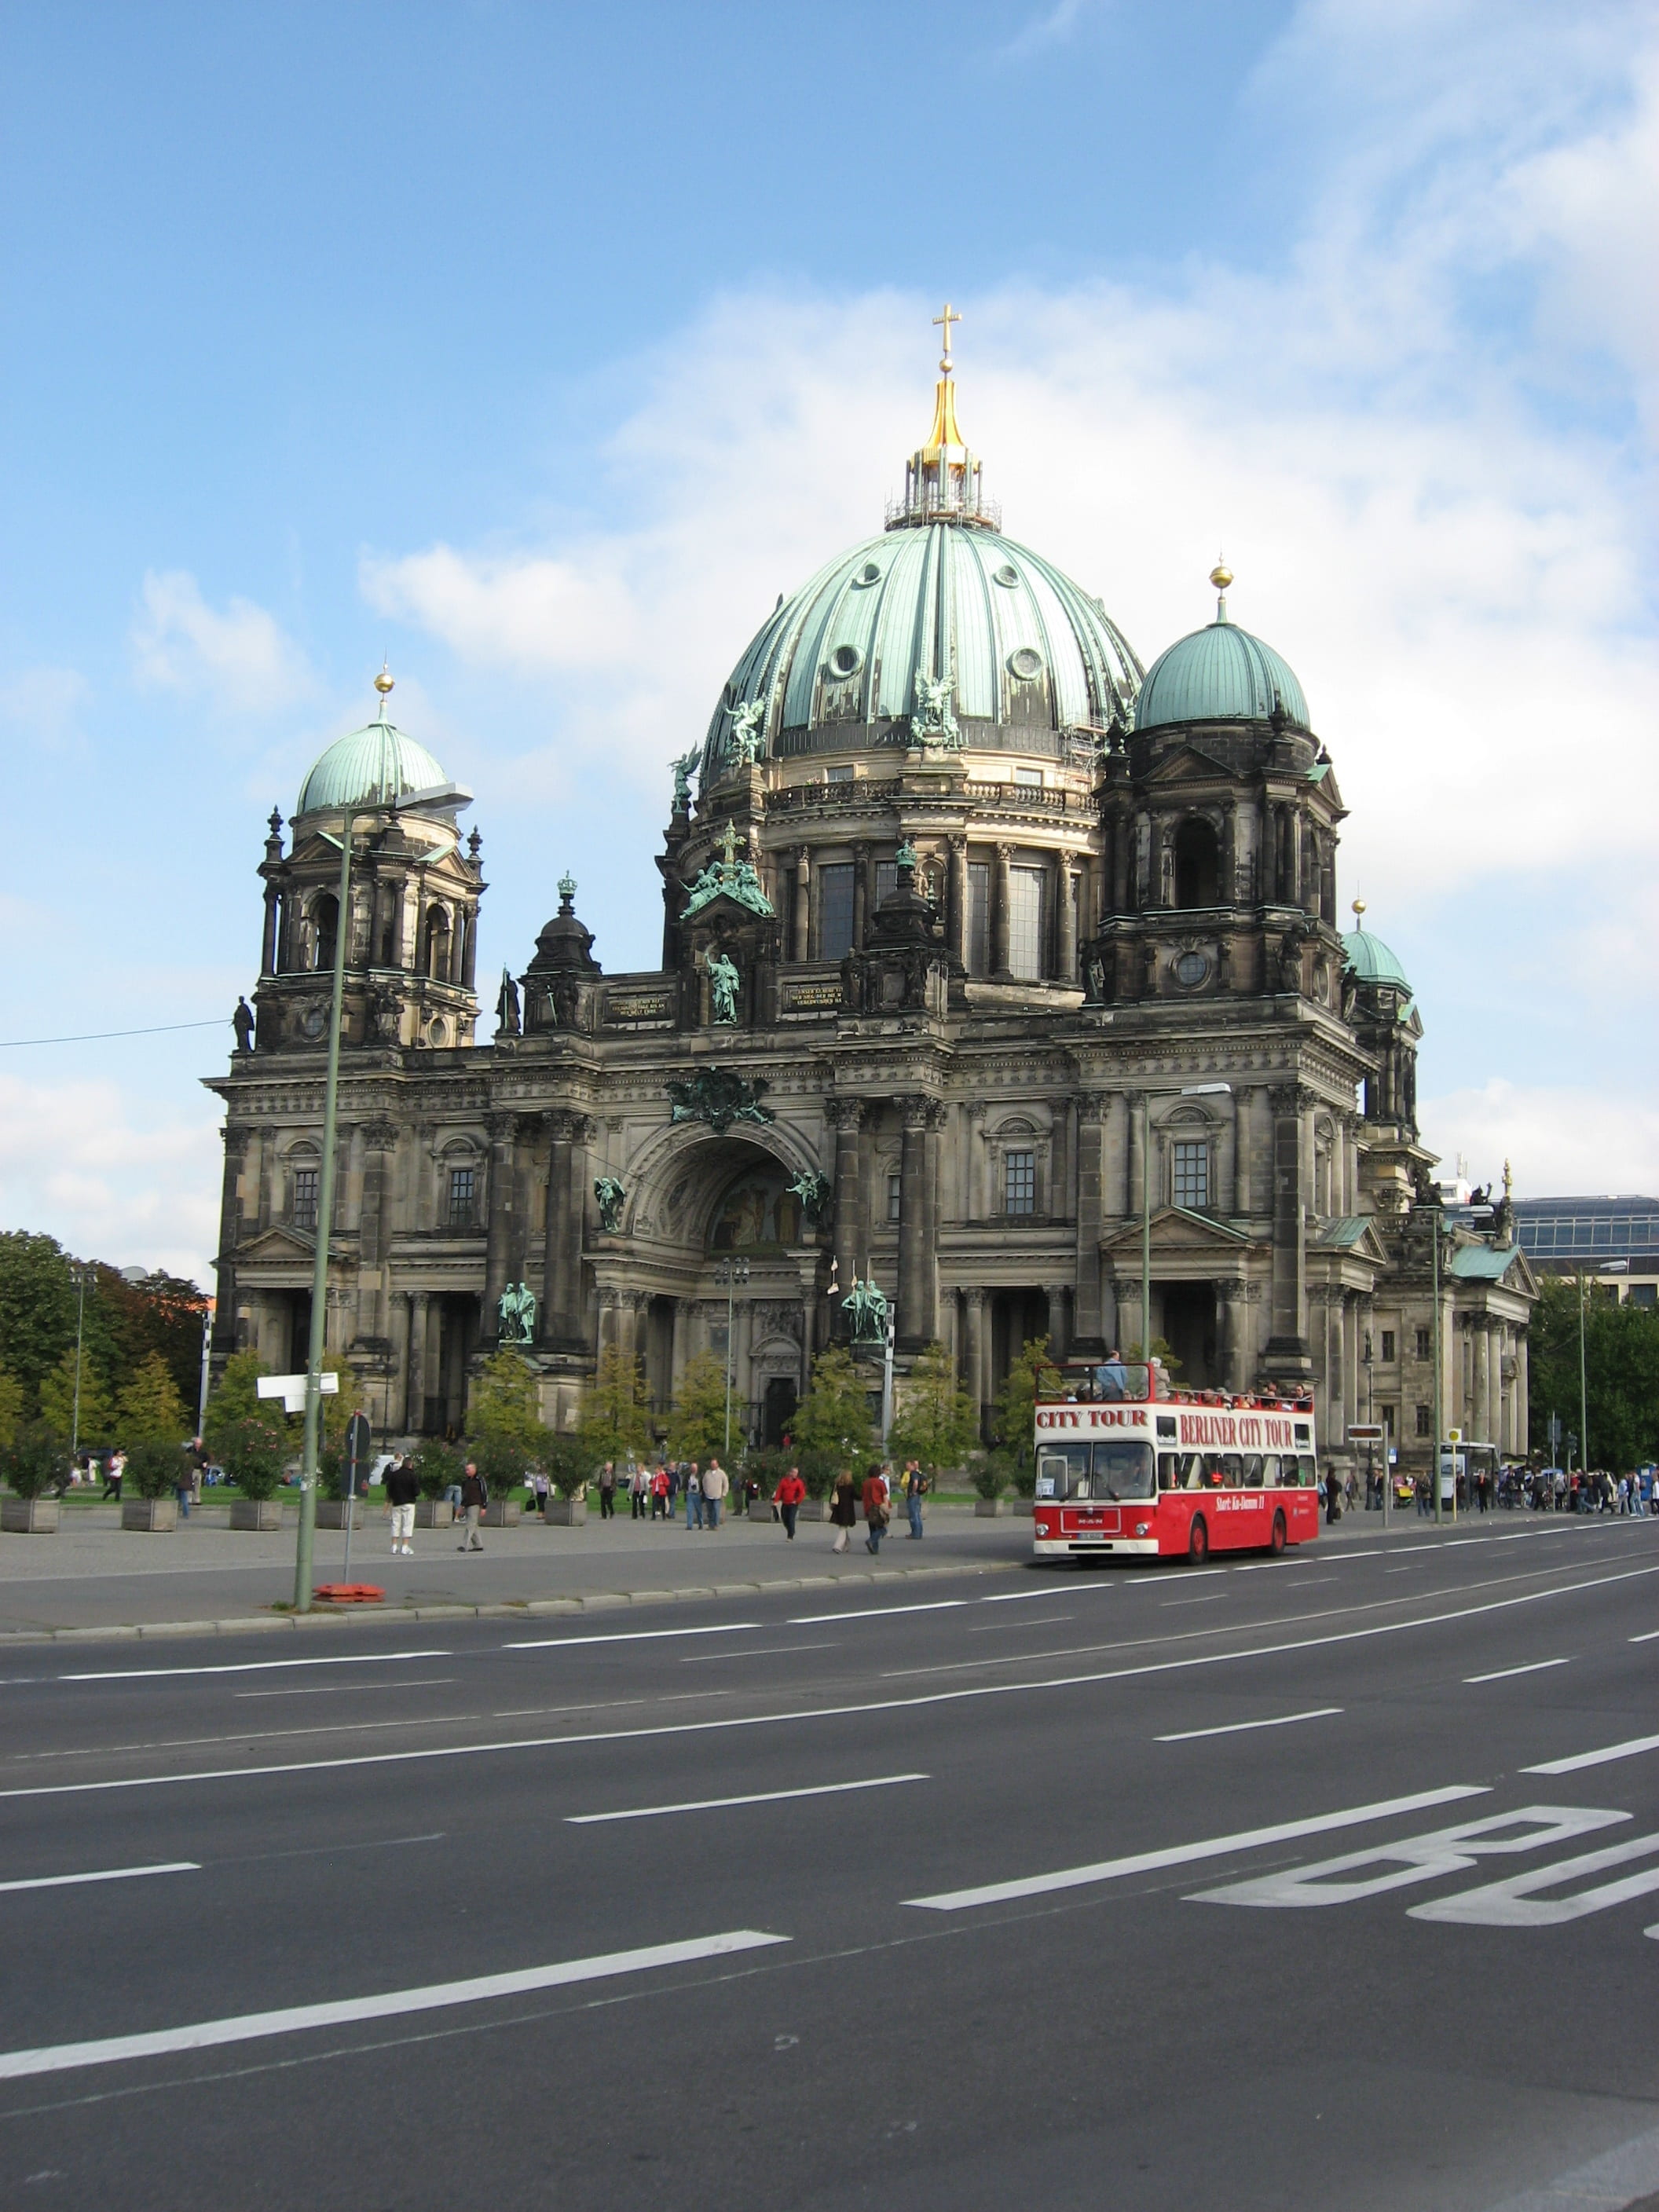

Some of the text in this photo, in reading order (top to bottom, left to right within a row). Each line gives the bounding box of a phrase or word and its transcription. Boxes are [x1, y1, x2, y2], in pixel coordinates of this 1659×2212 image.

[1036, 1410, 1148, 1429] CITY TOUR
[1180, 1414, 1292, 1448] BERLINER CITY TOUR
[1181, 1806, 1659, 1940] BU
